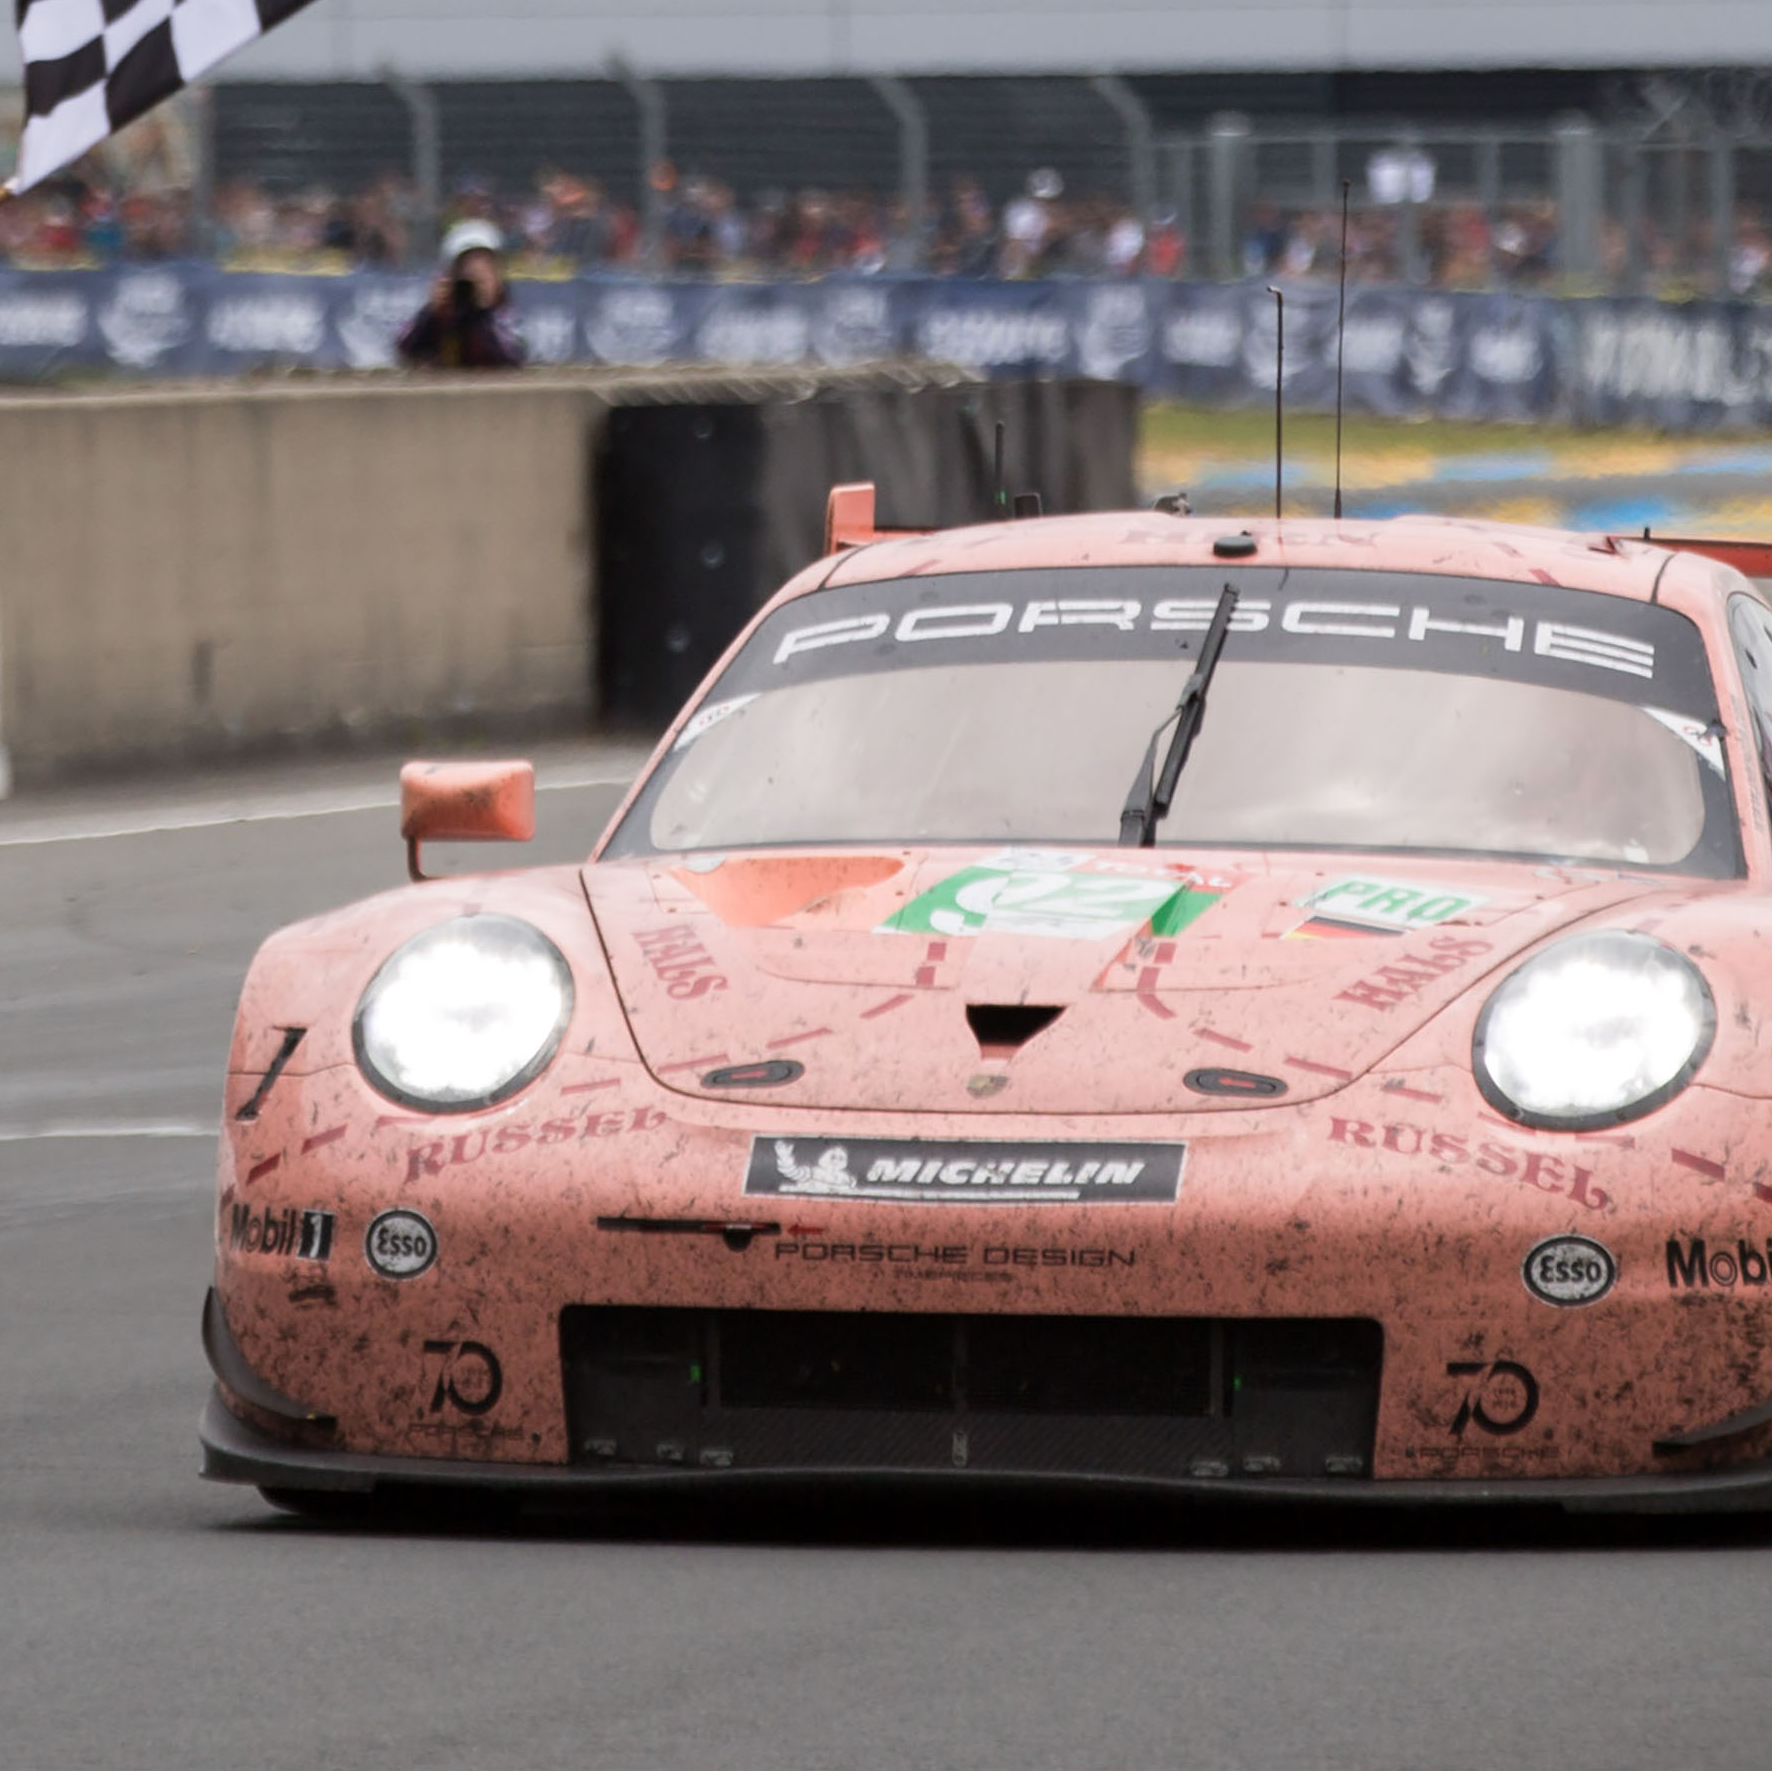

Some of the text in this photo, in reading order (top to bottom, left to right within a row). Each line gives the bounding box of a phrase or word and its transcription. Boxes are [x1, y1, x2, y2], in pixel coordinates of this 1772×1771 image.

[773, 598, 1655, 679] PORSCHE
[1324, 880, 1472, 921] PRO
[1332, 934, 1494, 1012] HALS
[866, 1157, 1146, 1185] MICHELIN
[1329, 1117, 1609, 1211] RUSSEL
[229, 1209, 297, 1256] Mobil
[377, 1226, 428, 1259] Esso
[775, 1242, 1137, 1268] PORSCHE DESIGN
[1539, 1254, 1603, 1283] Esso
